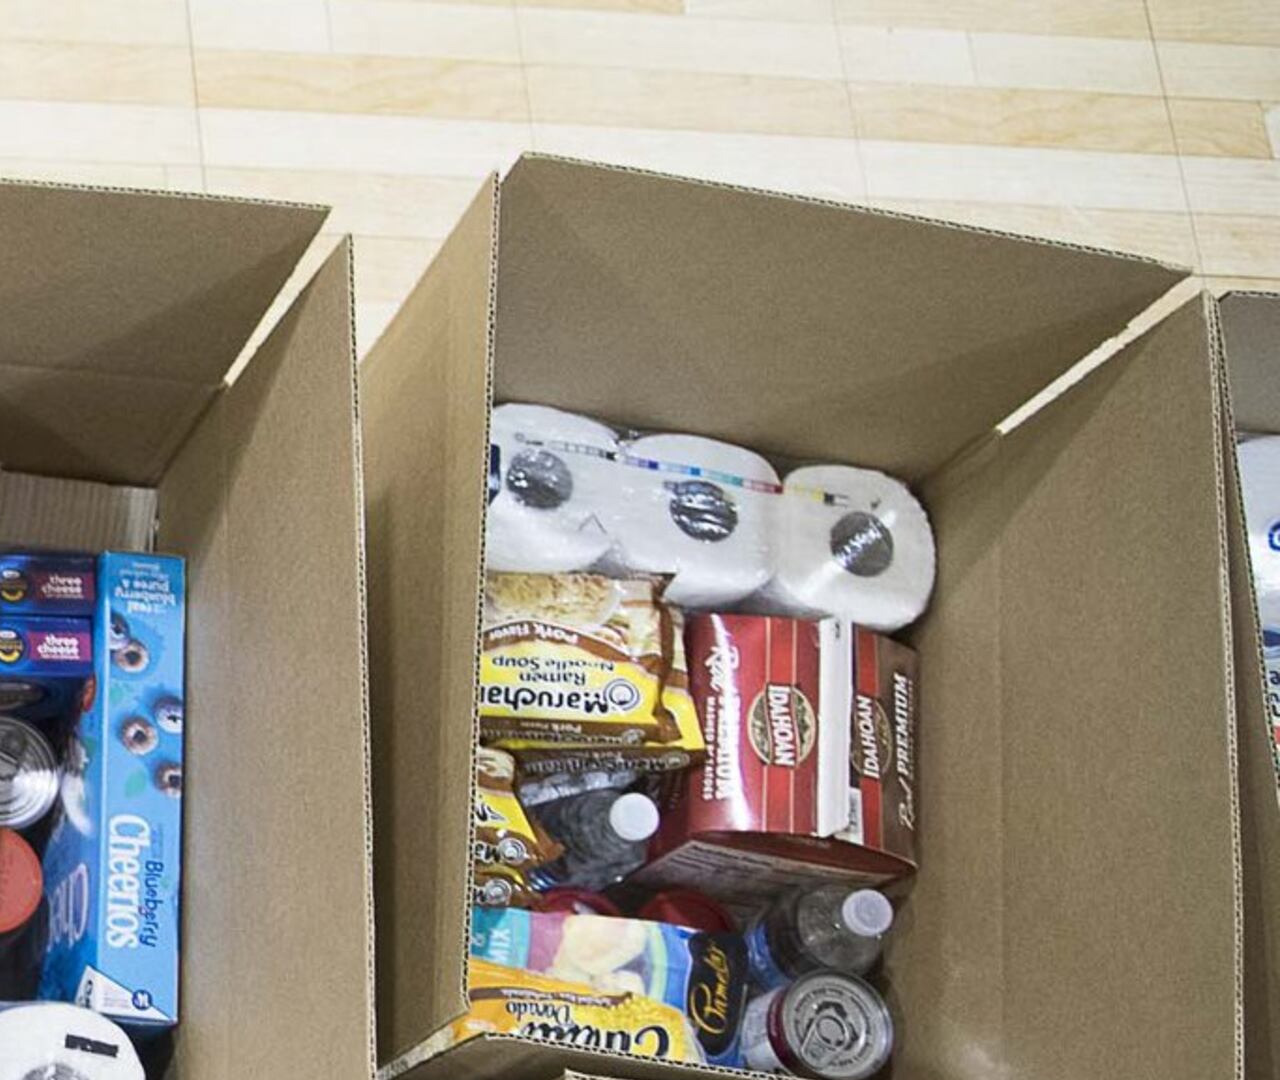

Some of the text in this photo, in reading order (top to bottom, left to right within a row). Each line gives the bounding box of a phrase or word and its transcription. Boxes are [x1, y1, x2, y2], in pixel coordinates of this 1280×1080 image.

[492, 655, 541, 671] Soup
[535, 624, 579, 645] Pork
[519, 673, 587, 686] Ramen
[767, 685, 796, 767] IDAHOAN
[857, 695, 881, 780] IDAHOAN
[893, 672, 909, 775] PREMIUM
[107, 814, 152, 949] Cheerios
[140, 860, 165, 948] Blueberry
[506, 1001, 571, 1024] Dorado
